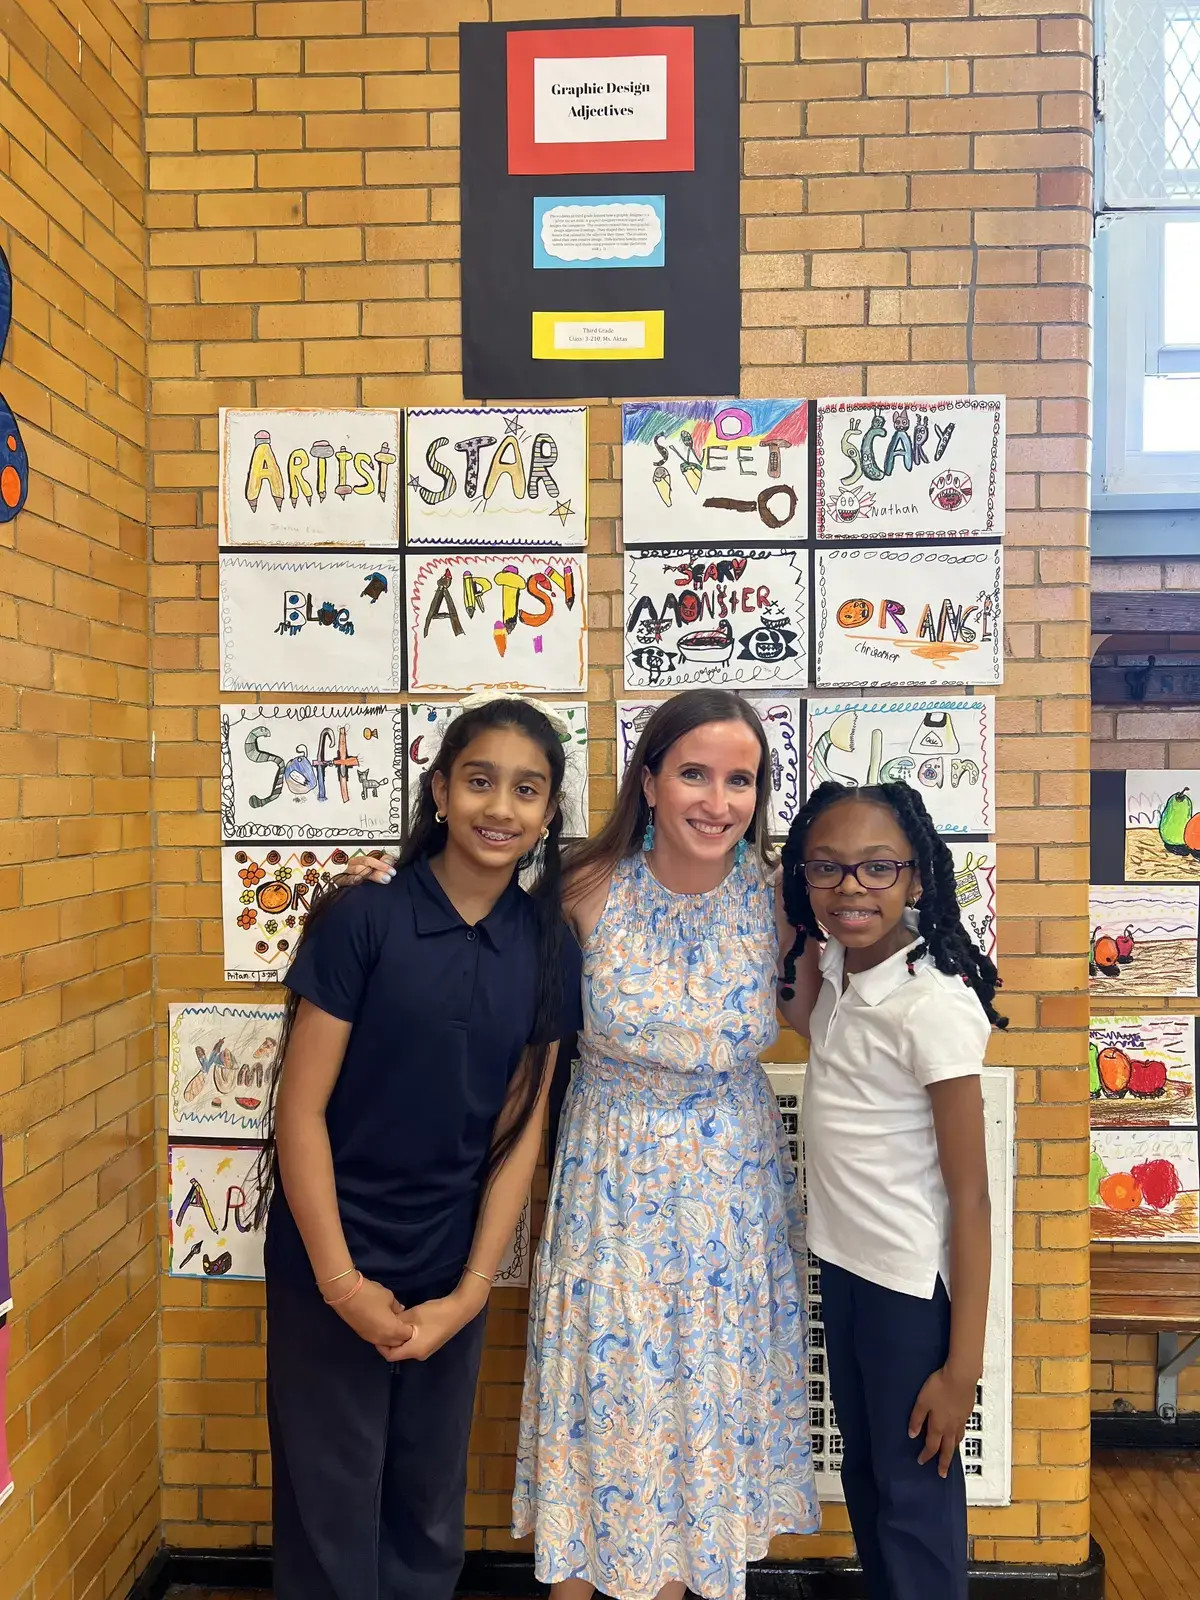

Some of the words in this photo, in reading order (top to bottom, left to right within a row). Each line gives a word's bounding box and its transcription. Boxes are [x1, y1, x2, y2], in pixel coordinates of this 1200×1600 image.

[551, 82, 604, 98] Graphic
[606, 81, 650, 96] Design
[567, 104, 634, 120] Adjectives
[419, 433, 560, 505] STAR
[840, 408, 956, 486] SCARY
[244, 430, 397, 513] ARTIST
[871, 503, 919, 518] Nathan
